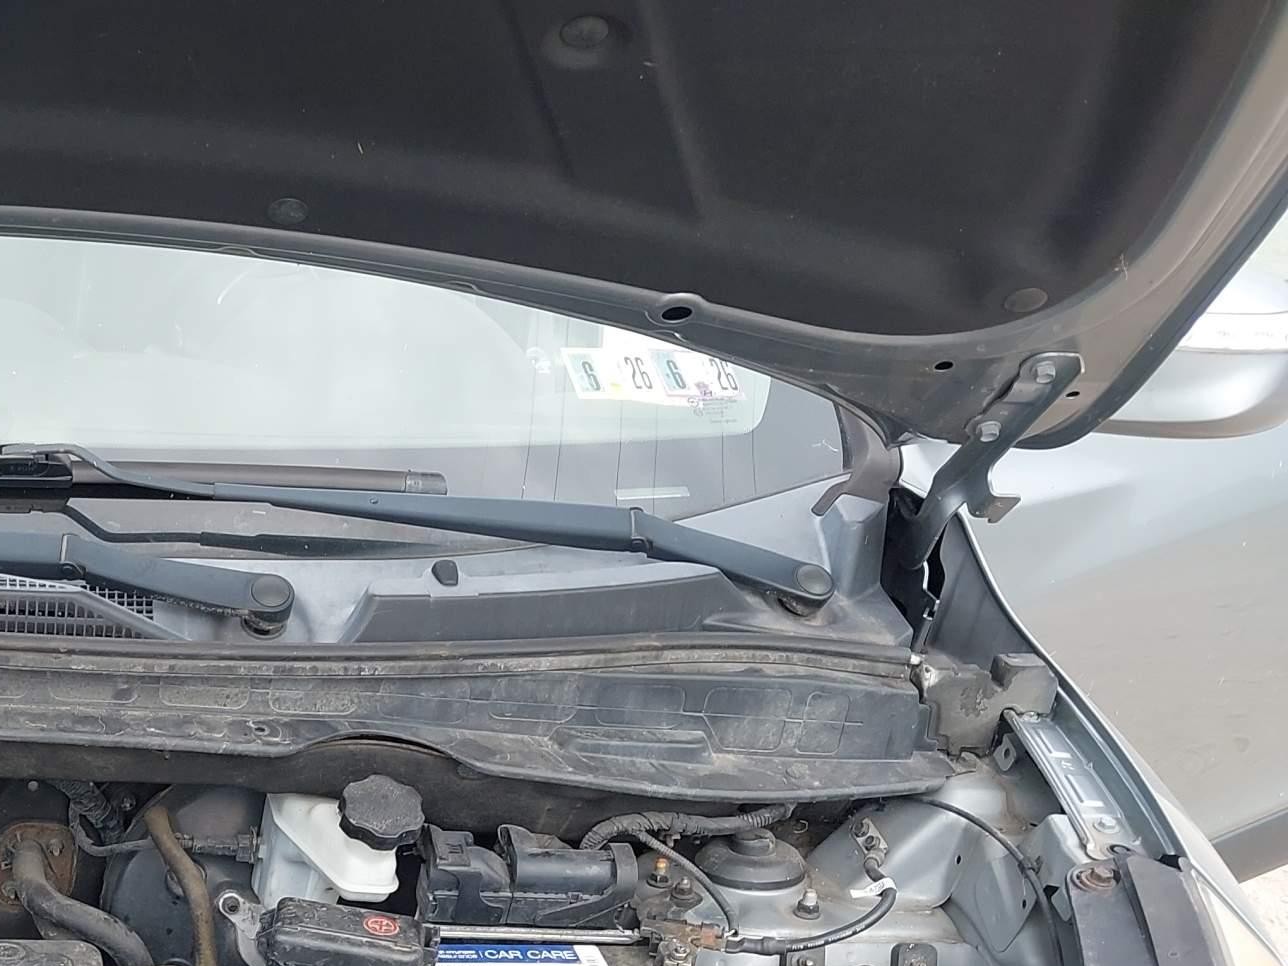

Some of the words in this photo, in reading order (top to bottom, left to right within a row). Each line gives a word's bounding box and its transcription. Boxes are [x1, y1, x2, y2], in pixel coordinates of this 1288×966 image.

[624, 356, 654, 390] 26
[484, 950, 523, 959] CAR
[527, 950, 578, 960] CARE
